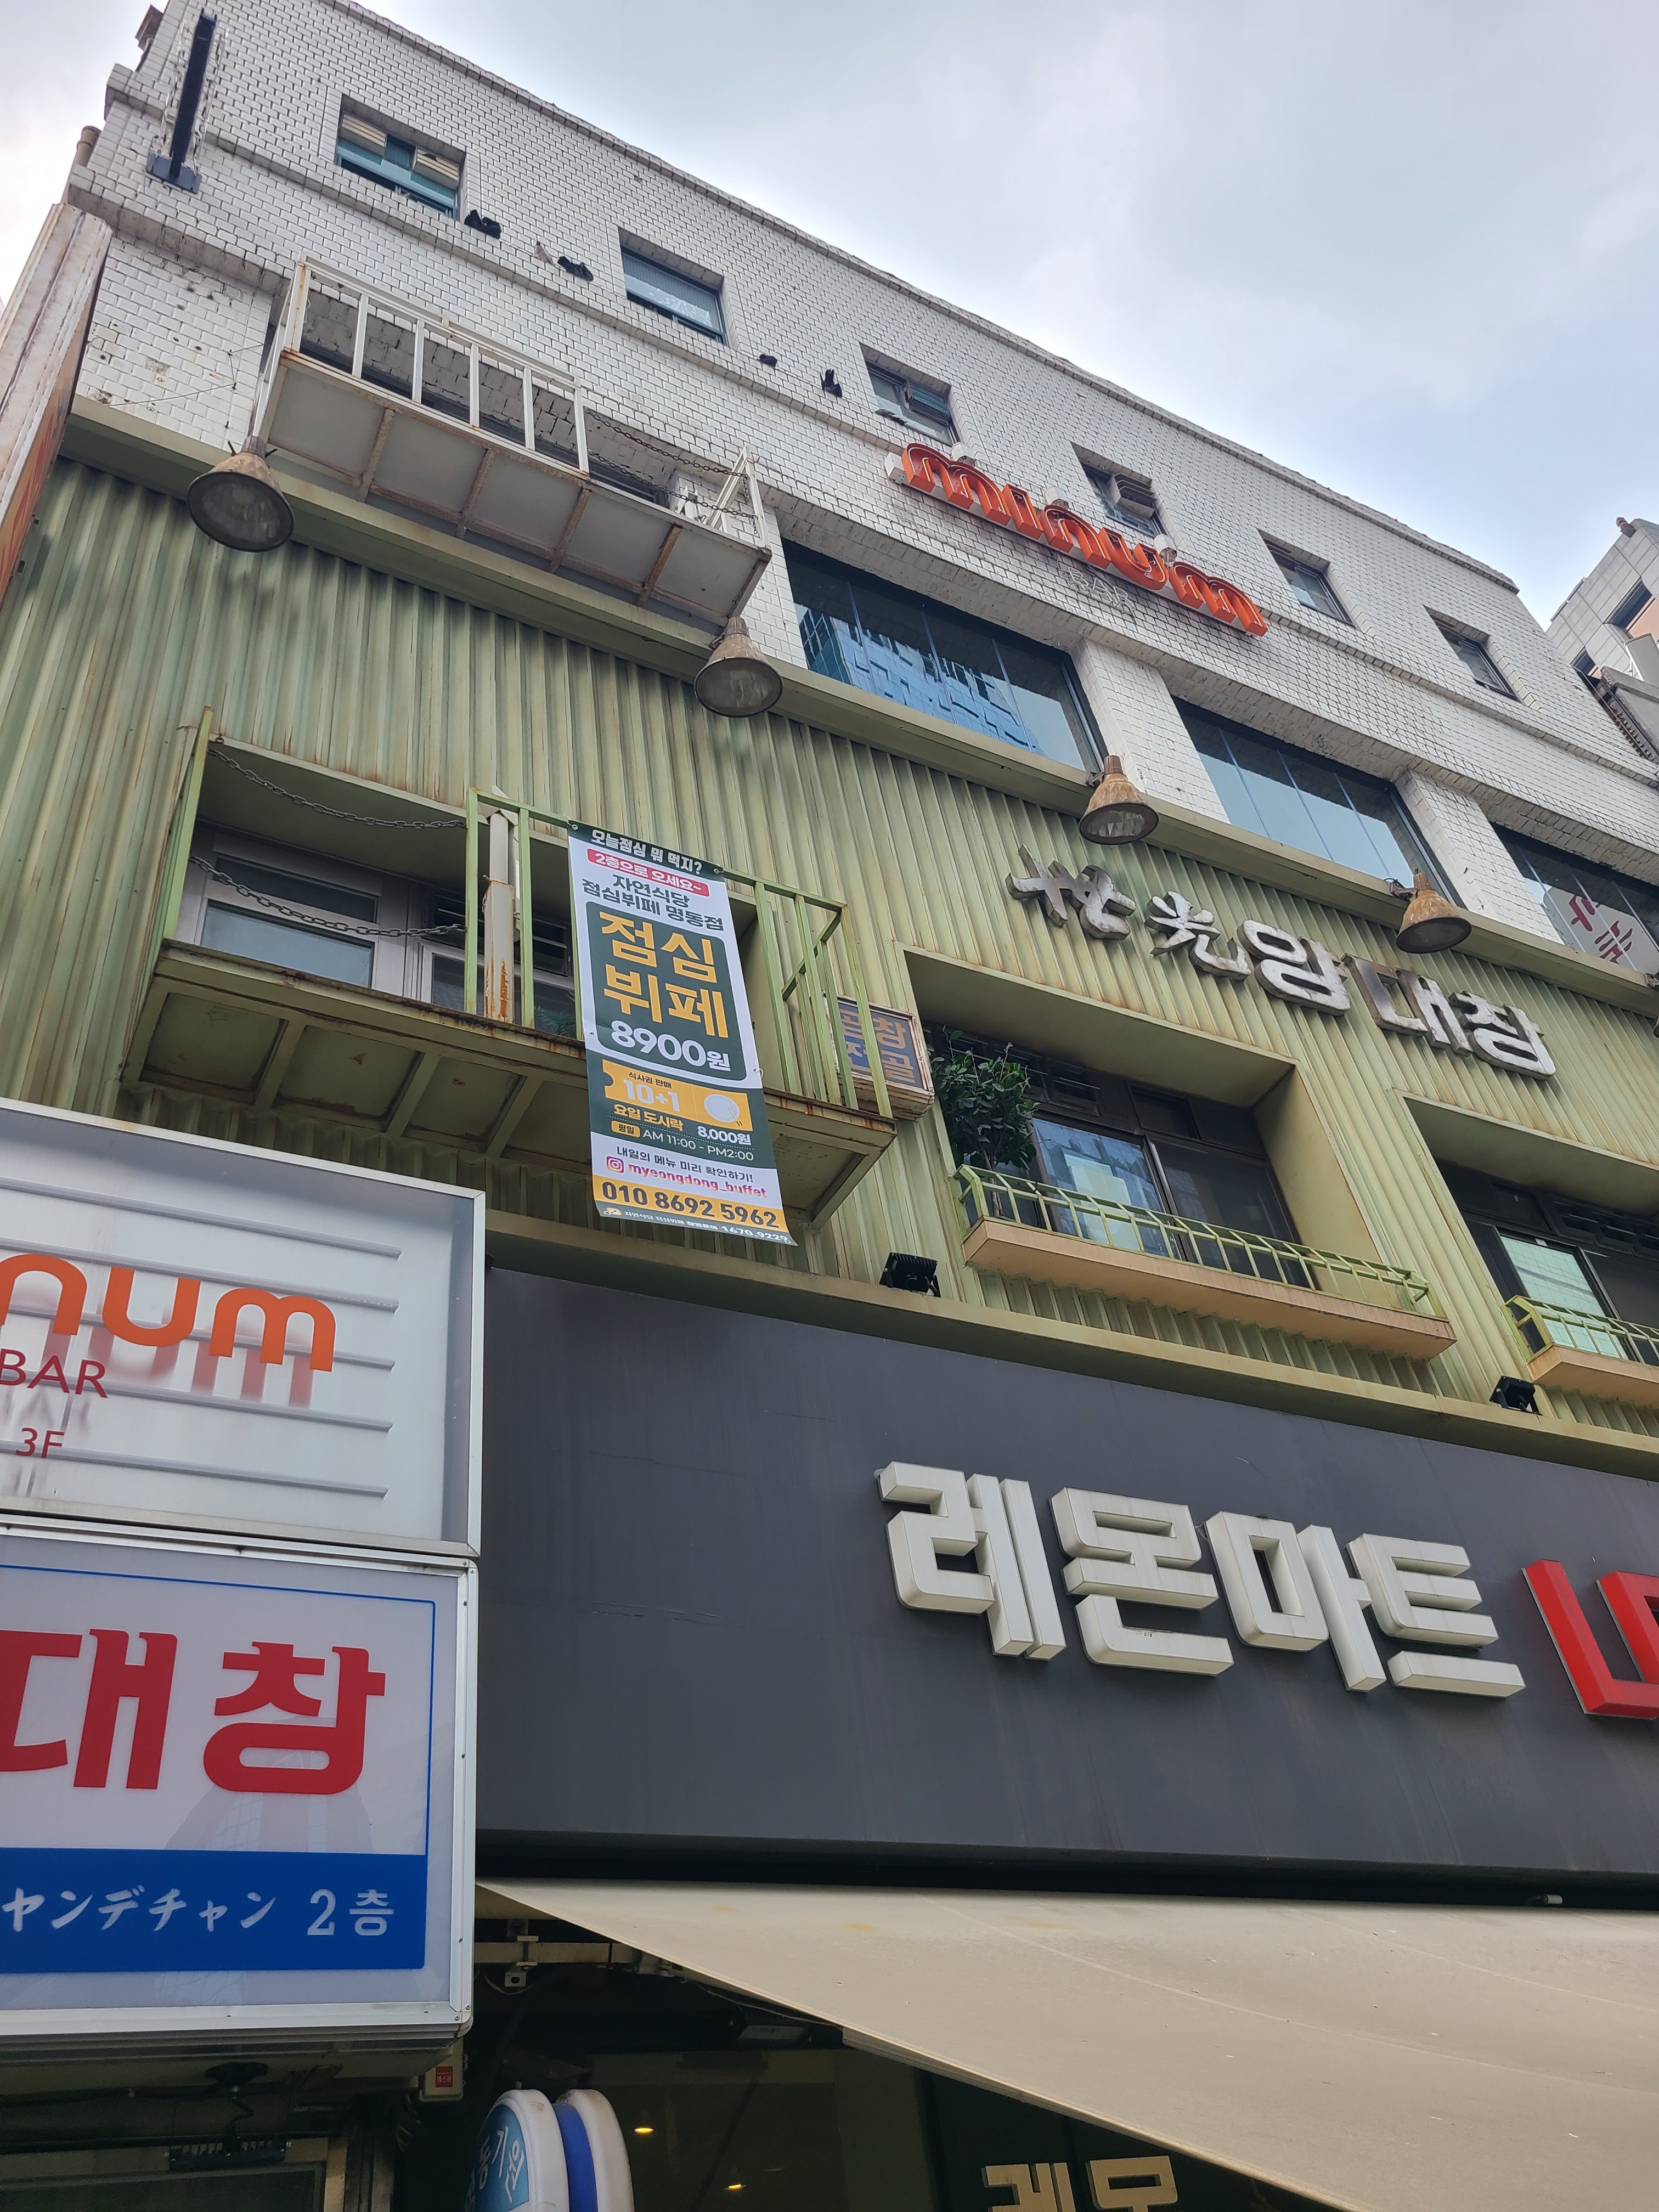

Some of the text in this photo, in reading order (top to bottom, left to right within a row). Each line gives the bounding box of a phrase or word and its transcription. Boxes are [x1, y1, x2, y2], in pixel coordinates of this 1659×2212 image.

[591, 830, 702, 874] 오늘점심 뭐 먹지?
[595, 853, 648, 878] 2층으로
[582, 879, 724, 931] 점심뷔페 명동점
[613, 874, 690, 908] 자연식당
[599, 911, 717, 983] 점심
[603, 964, 729, 1038] 뷔페
[611, 1021, 731, 1071] 8900원
[623, 1079, 680, 1111] 10+1
[629, 1071, 672, 1089] 식사권 판매
[614, 1104, 641, 1120] 요일
[644, 1112, 684, 1131] 도시락
[617, 1146, 753, 1183] 내일의 메뉴 미리 확인하기!
[618, 1124, 635, 1135] 평일
[643, 1130, 663, 1142] AM
[667, 1134, 696, 1149] 11:00
[708, 1145, 754, 1161] PM2:00
[628, 1163, 767, 1198] myeongdong_buffet
[602, 1181, 779, 1228] 010 8692 5962
[0, 1348, 108, 1398] BAR
[15, 1427, 65, 1459] 3F
[878, 1460, 1526, 1698] 레몬마트
[0, 1628, 386, 1795] 대창
[307, 1888, 394, 1937] 2층
